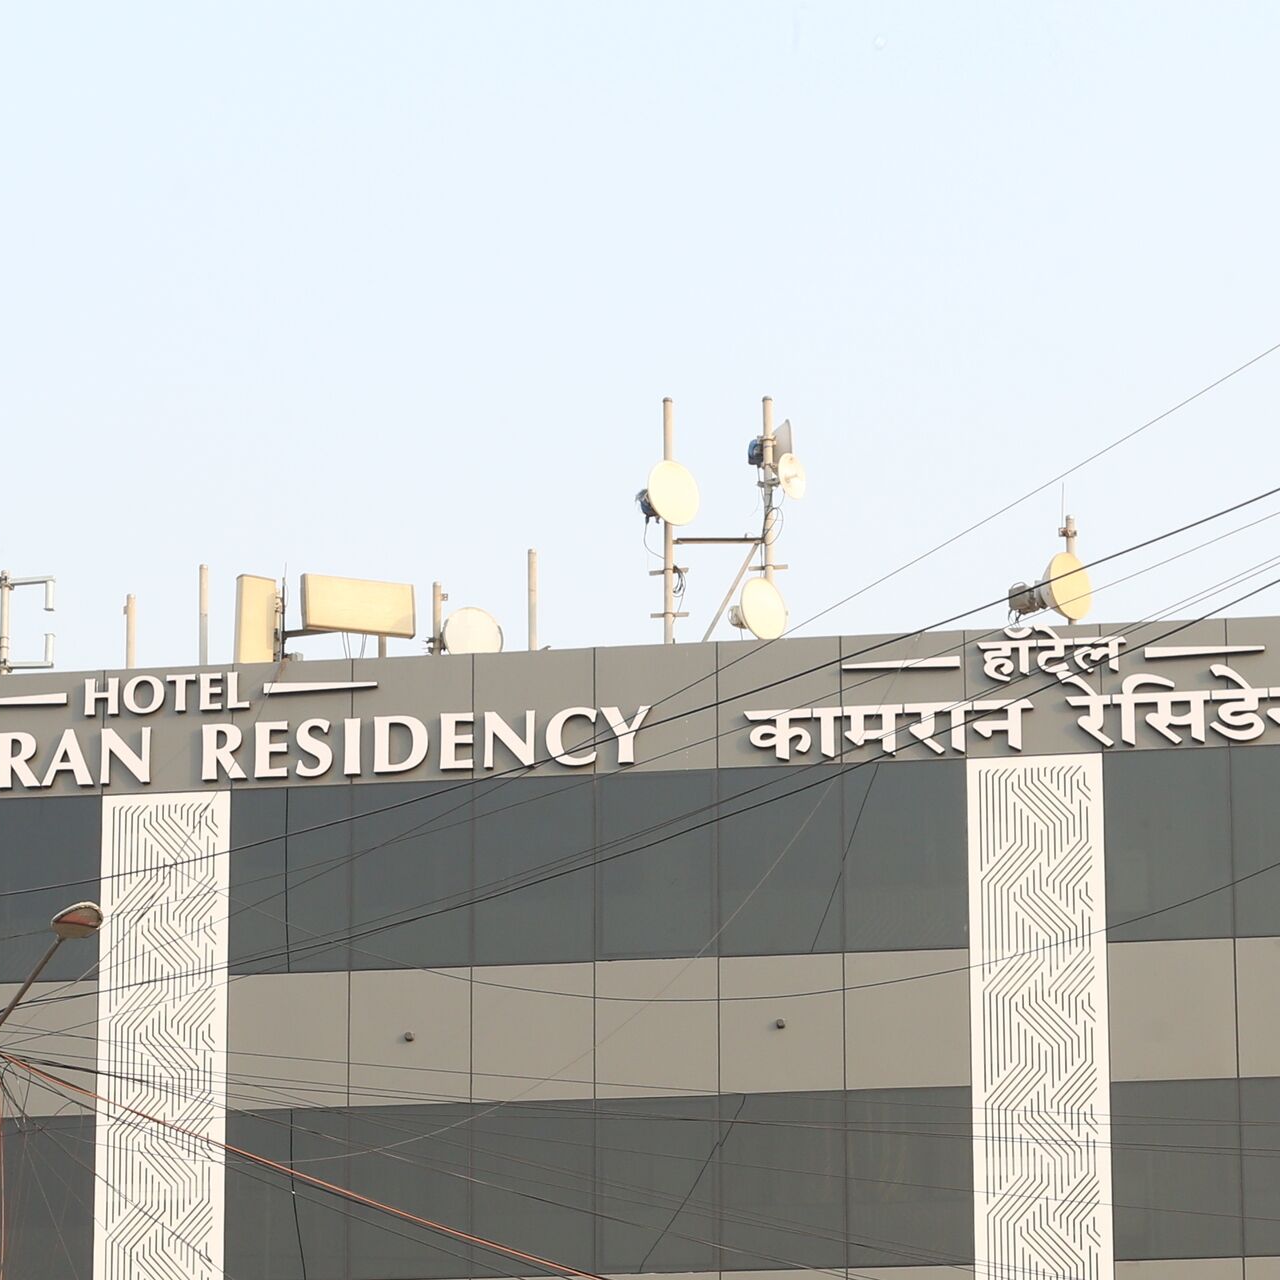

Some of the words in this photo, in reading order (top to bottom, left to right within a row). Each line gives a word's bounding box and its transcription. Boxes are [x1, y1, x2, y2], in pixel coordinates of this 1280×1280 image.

[977, 626, 1126, 682] हॉटेल
[84, 672, 251, 718] HOTEL
[202, 704, 652, 782] RESIDENCY
[743, 699, 1033, 762] कामरान
